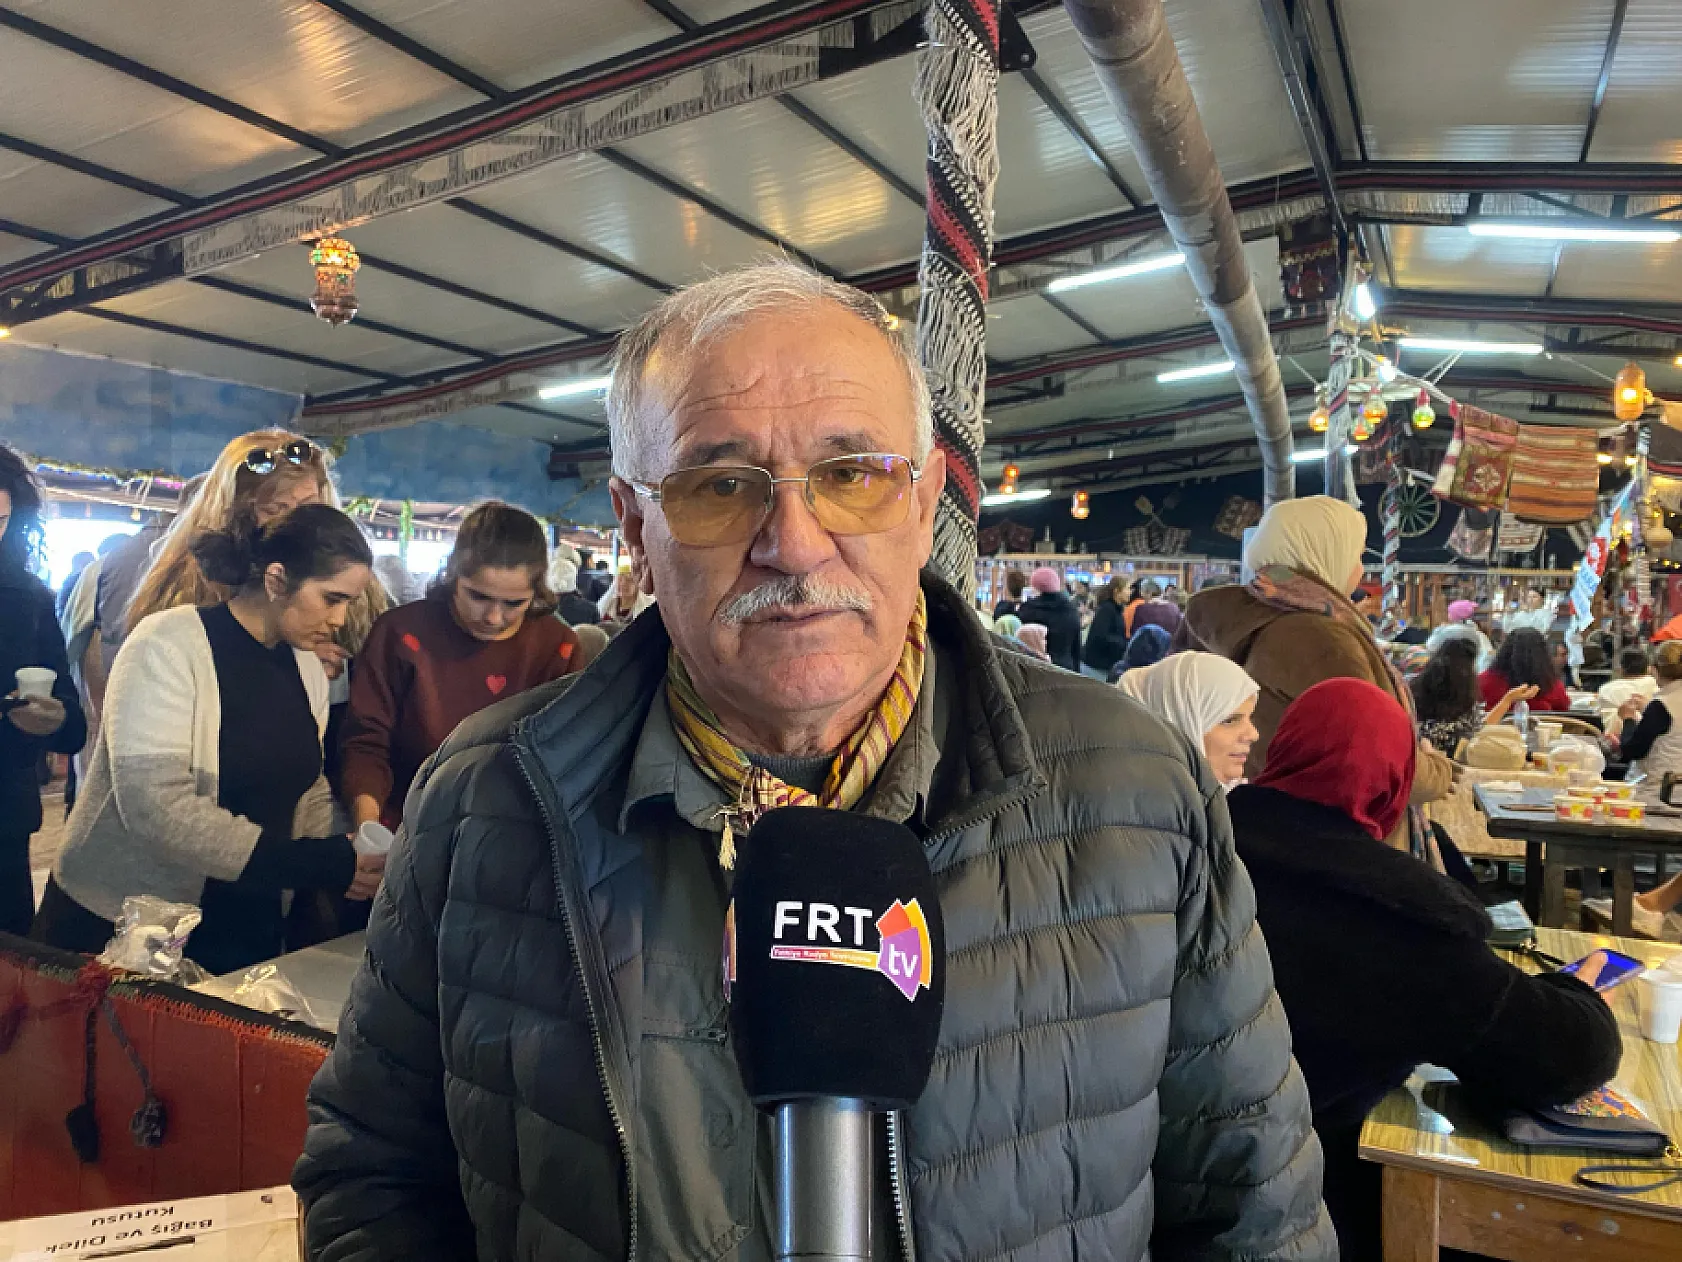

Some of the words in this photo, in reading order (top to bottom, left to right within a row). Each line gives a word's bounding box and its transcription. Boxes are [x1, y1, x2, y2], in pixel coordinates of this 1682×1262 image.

[774, 901, 872, 945] FRT
[888, 944, 917, 977] tv
[91, 1206, 174, 1227] Kutusu
[46, 1236, 107, 1253] Dilek
[115, 1229, 143, 1240] ve
